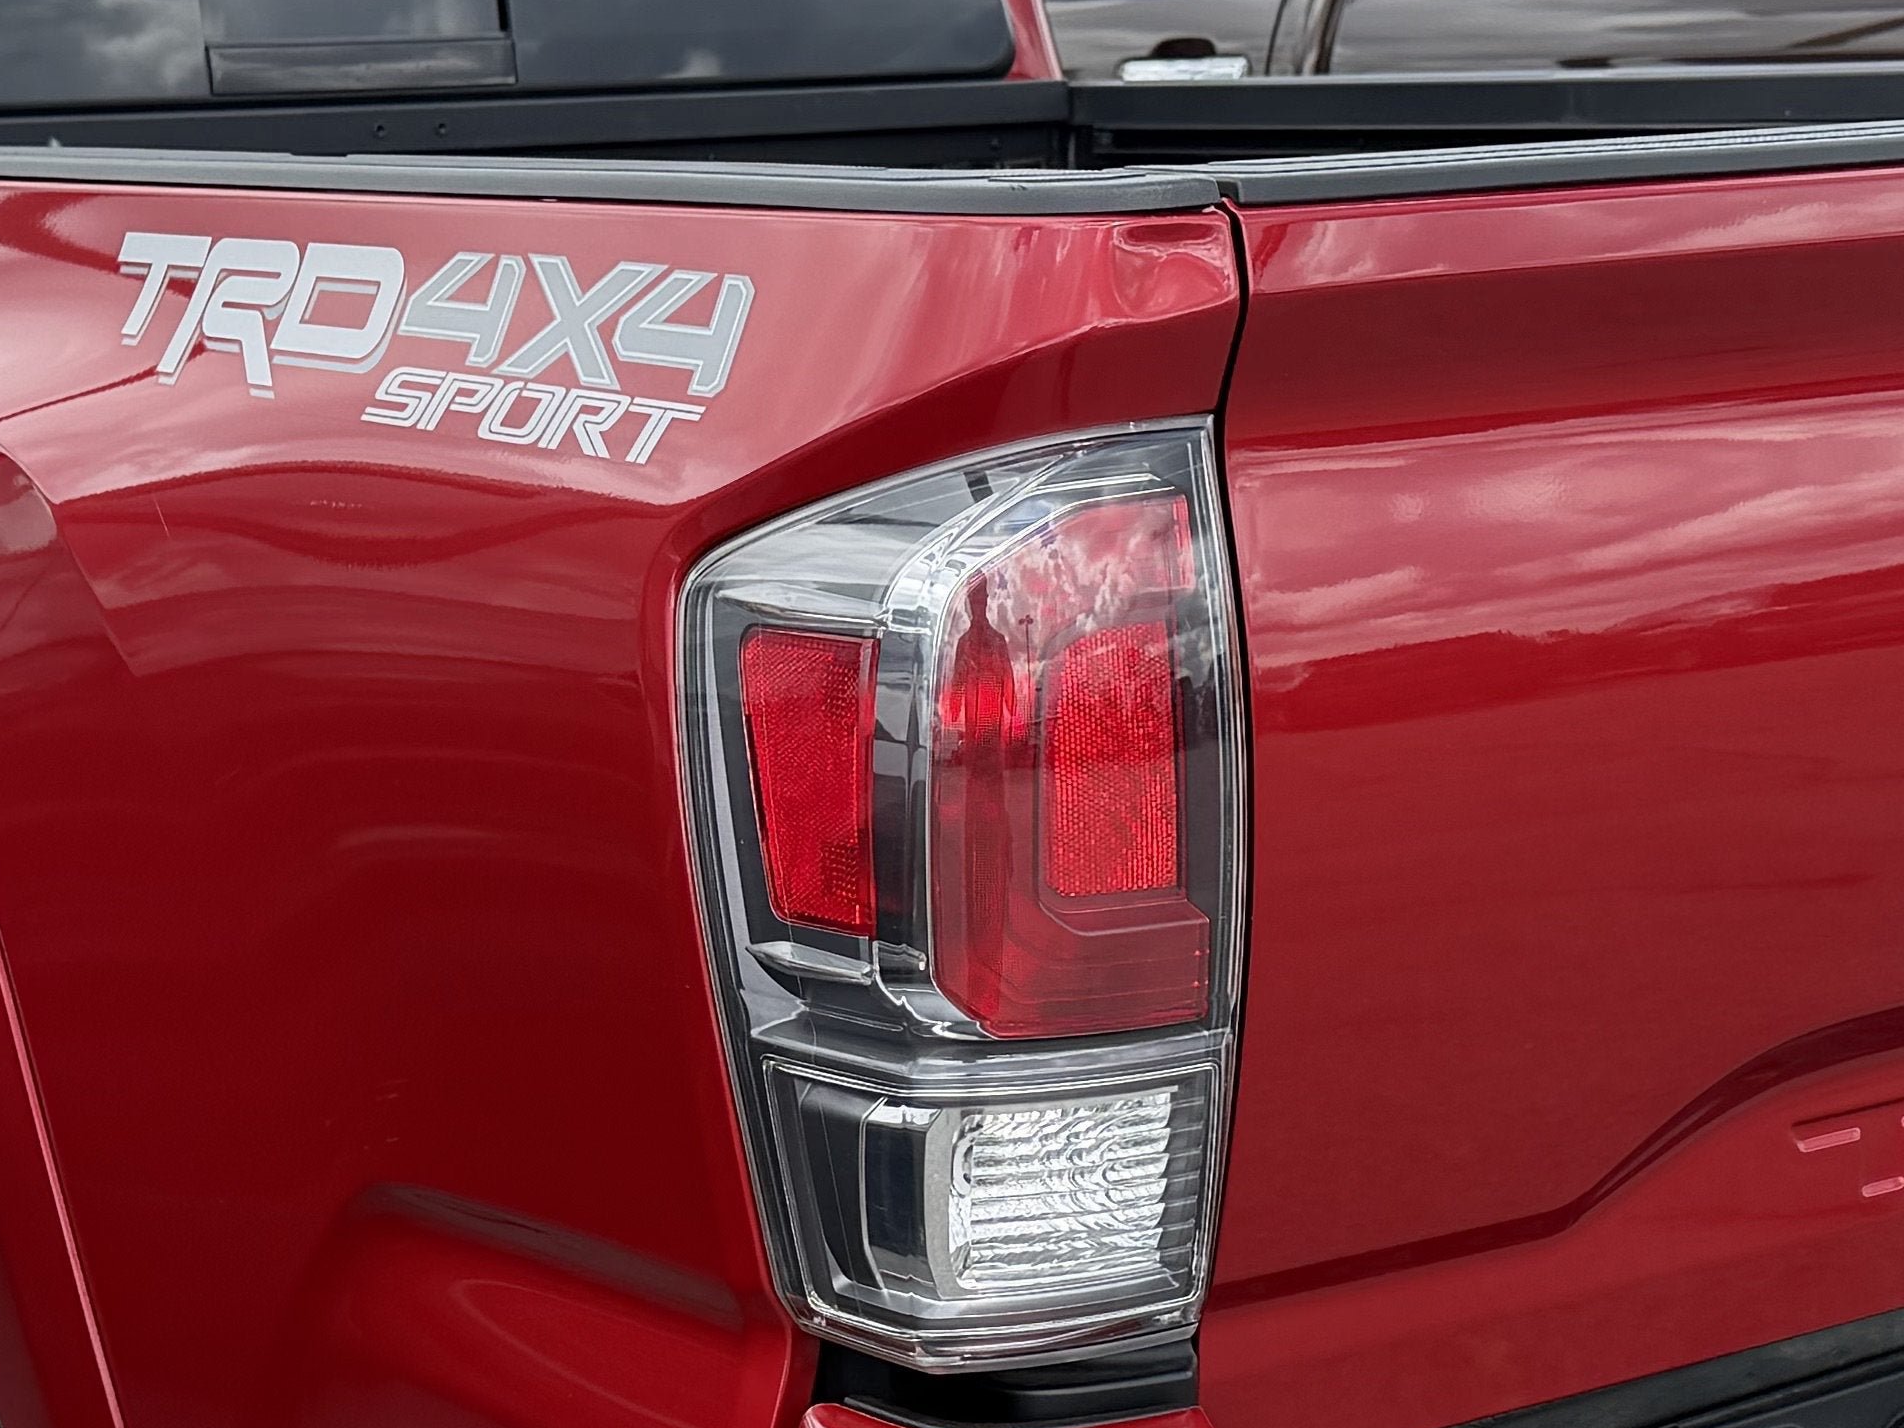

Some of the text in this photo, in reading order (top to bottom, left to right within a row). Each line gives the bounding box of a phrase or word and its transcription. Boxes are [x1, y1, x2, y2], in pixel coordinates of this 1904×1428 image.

[118, 231, 756, 399] TRD 4X4
[360, 367, 707, 465] SPORT
